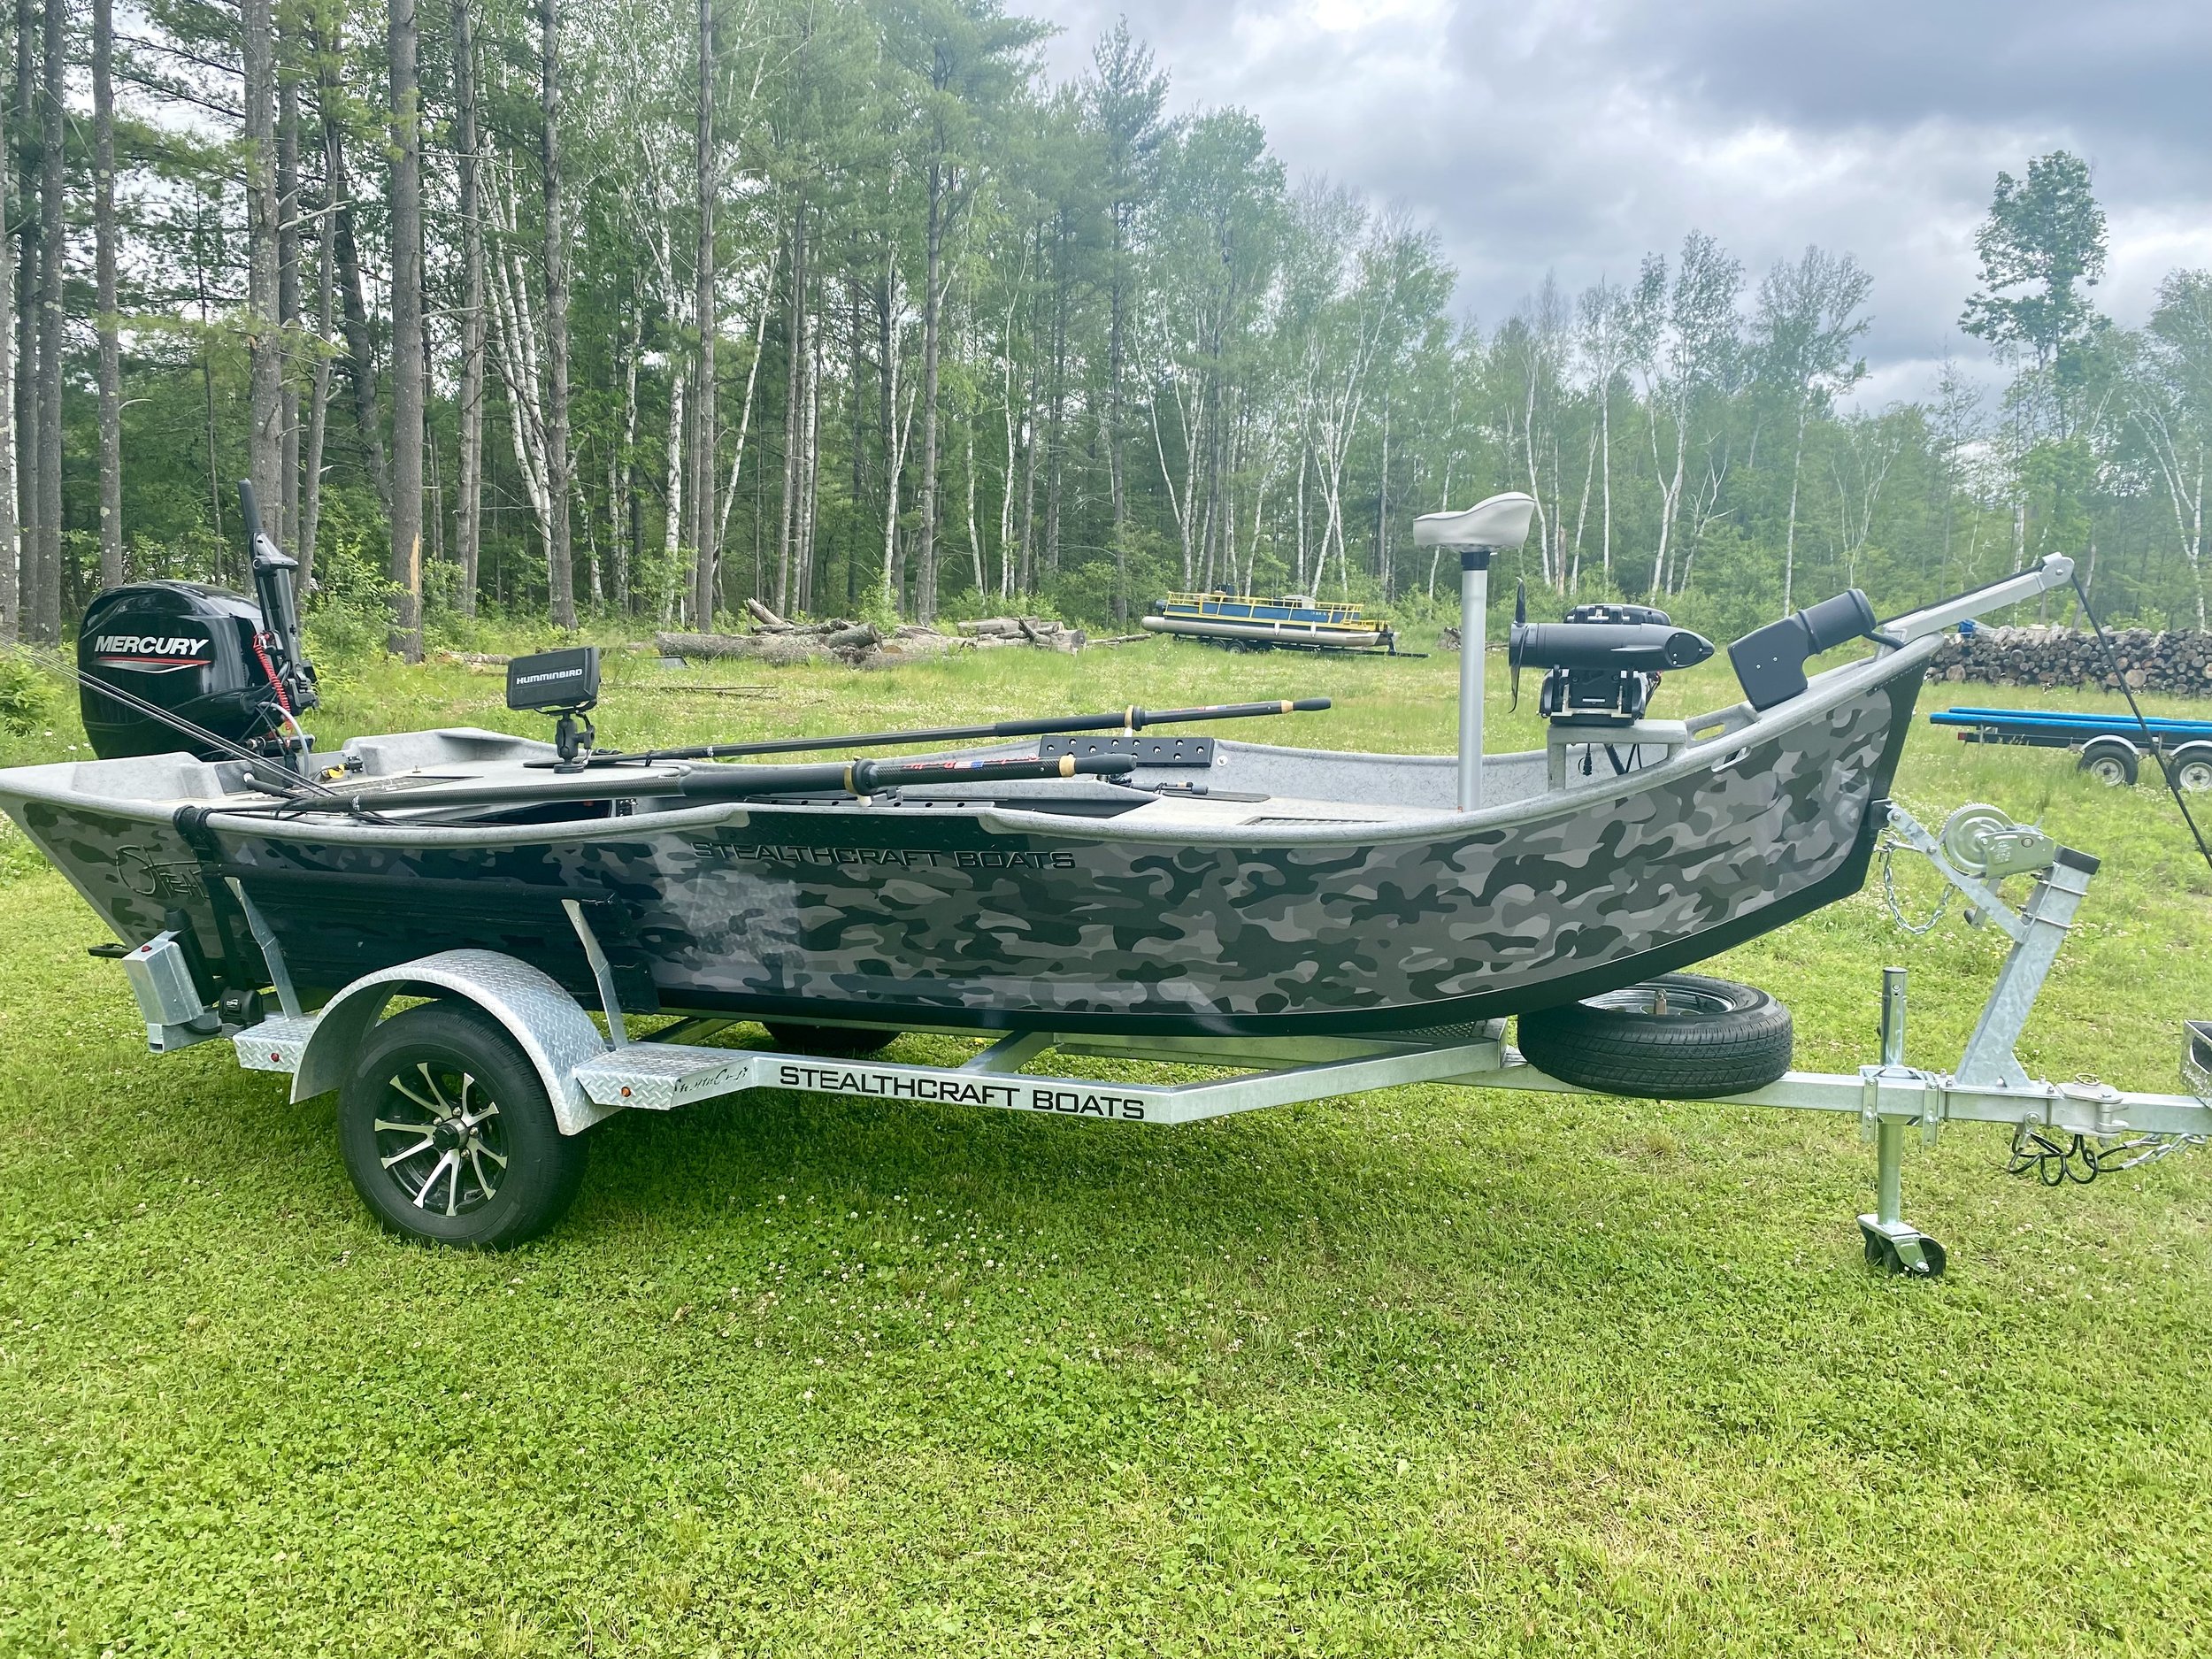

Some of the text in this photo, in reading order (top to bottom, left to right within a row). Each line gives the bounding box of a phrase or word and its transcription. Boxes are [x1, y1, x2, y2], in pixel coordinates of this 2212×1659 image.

[95, 635, 210, 656] MERCURY
[516, 668, 583, 684] HUMMINBIRD
[690, 841, 1077, 870] STEALTHCRAFT BOATS
[780, 1065, 1145, 1120] STEALTHCRAFT BOATS
